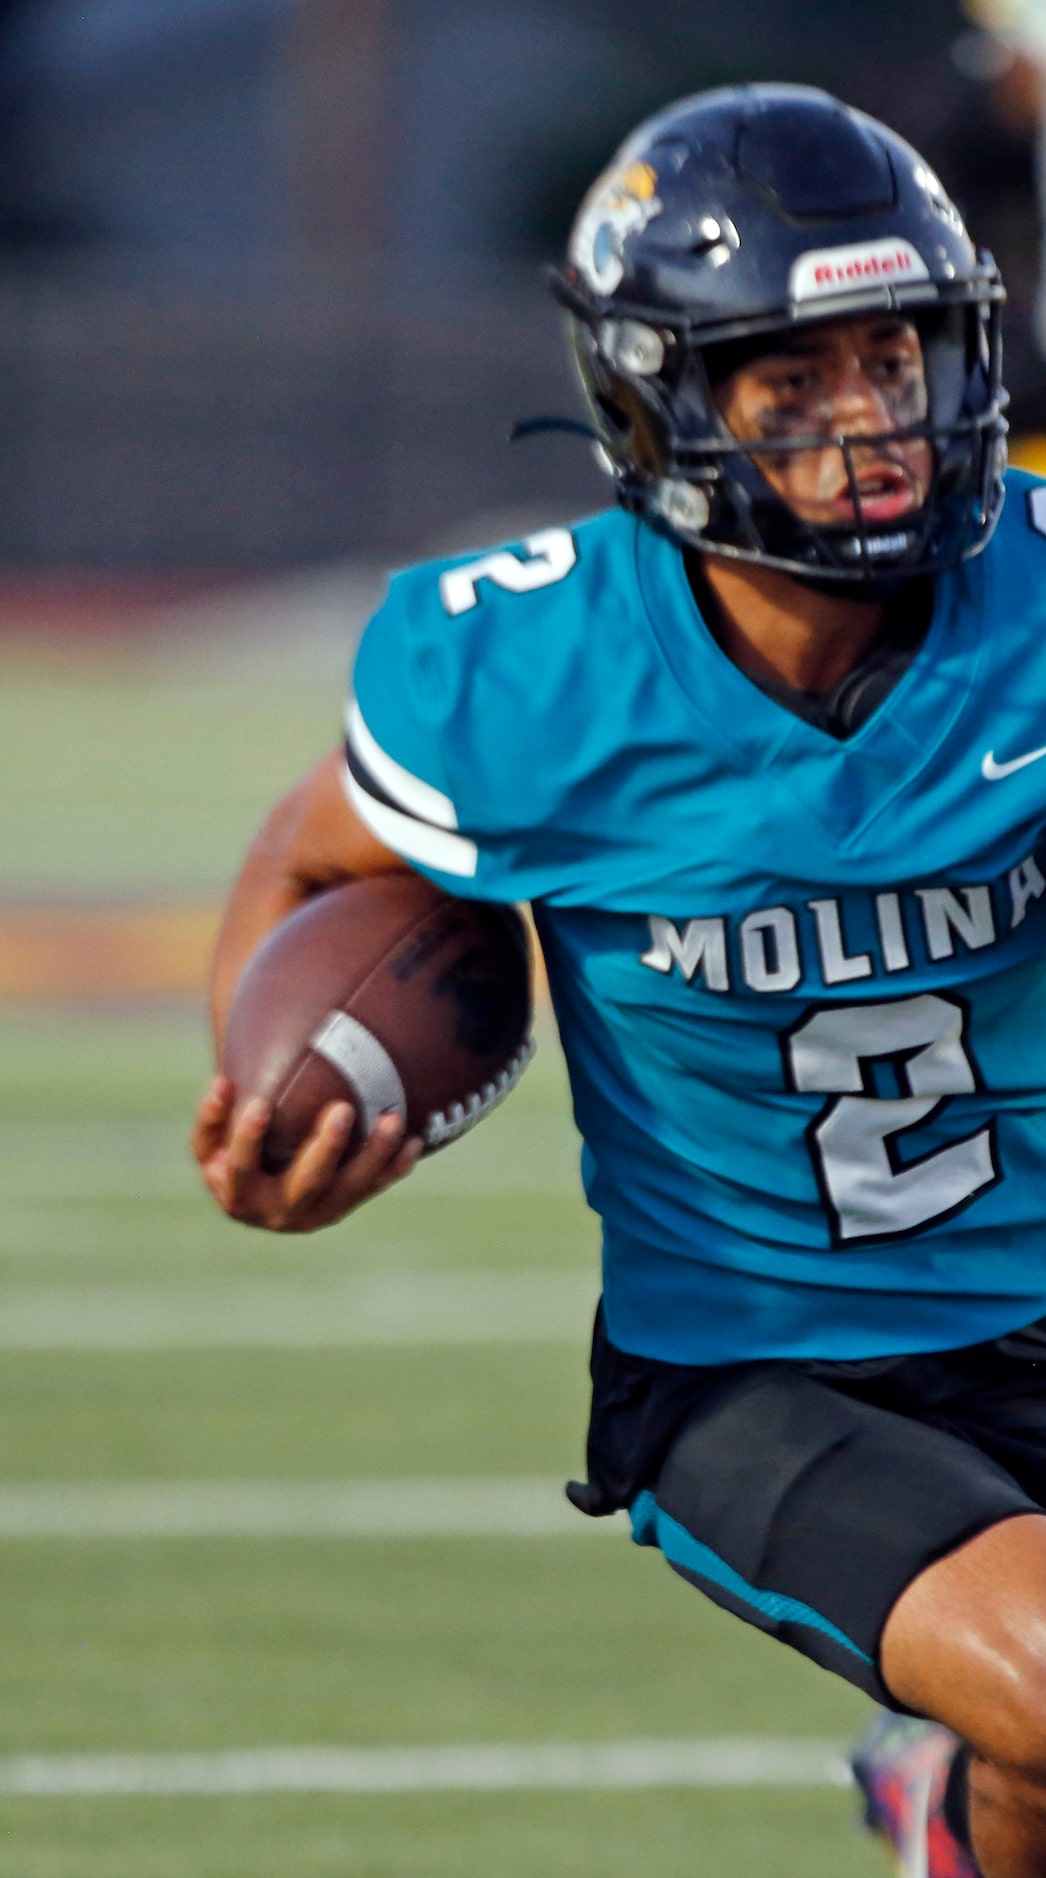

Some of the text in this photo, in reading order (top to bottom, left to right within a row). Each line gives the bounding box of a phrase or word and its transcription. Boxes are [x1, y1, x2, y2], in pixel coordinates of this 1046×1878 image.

[813, 250, 912, 285] Riddell
[440, 526, 580, 617] 2
[781, 994, 1004, 1250] 2
